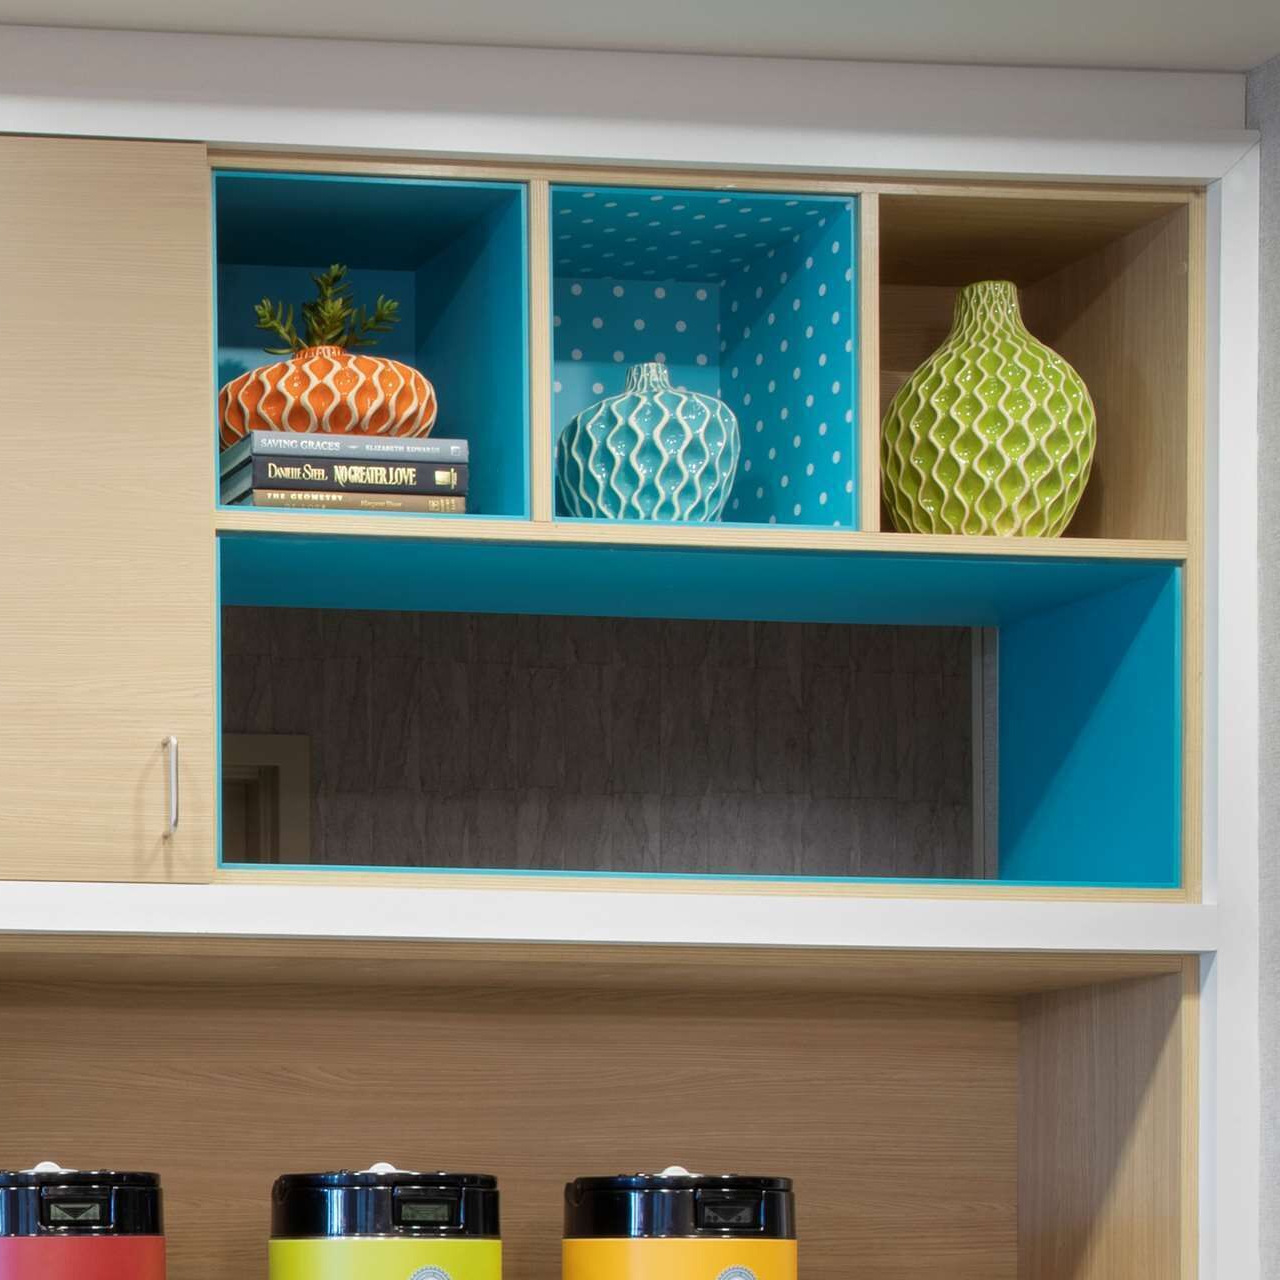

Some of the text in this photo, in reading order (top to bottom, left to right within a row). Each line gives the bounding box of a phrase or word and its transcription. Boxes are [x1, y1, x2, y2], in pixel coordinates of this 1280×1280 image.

[261, 438, 341, 451] SAVING GRACES
[333, 465, 417, 488] NO GREATER LOVE
[267, 492, 343, 502] THE GEOMETRY
